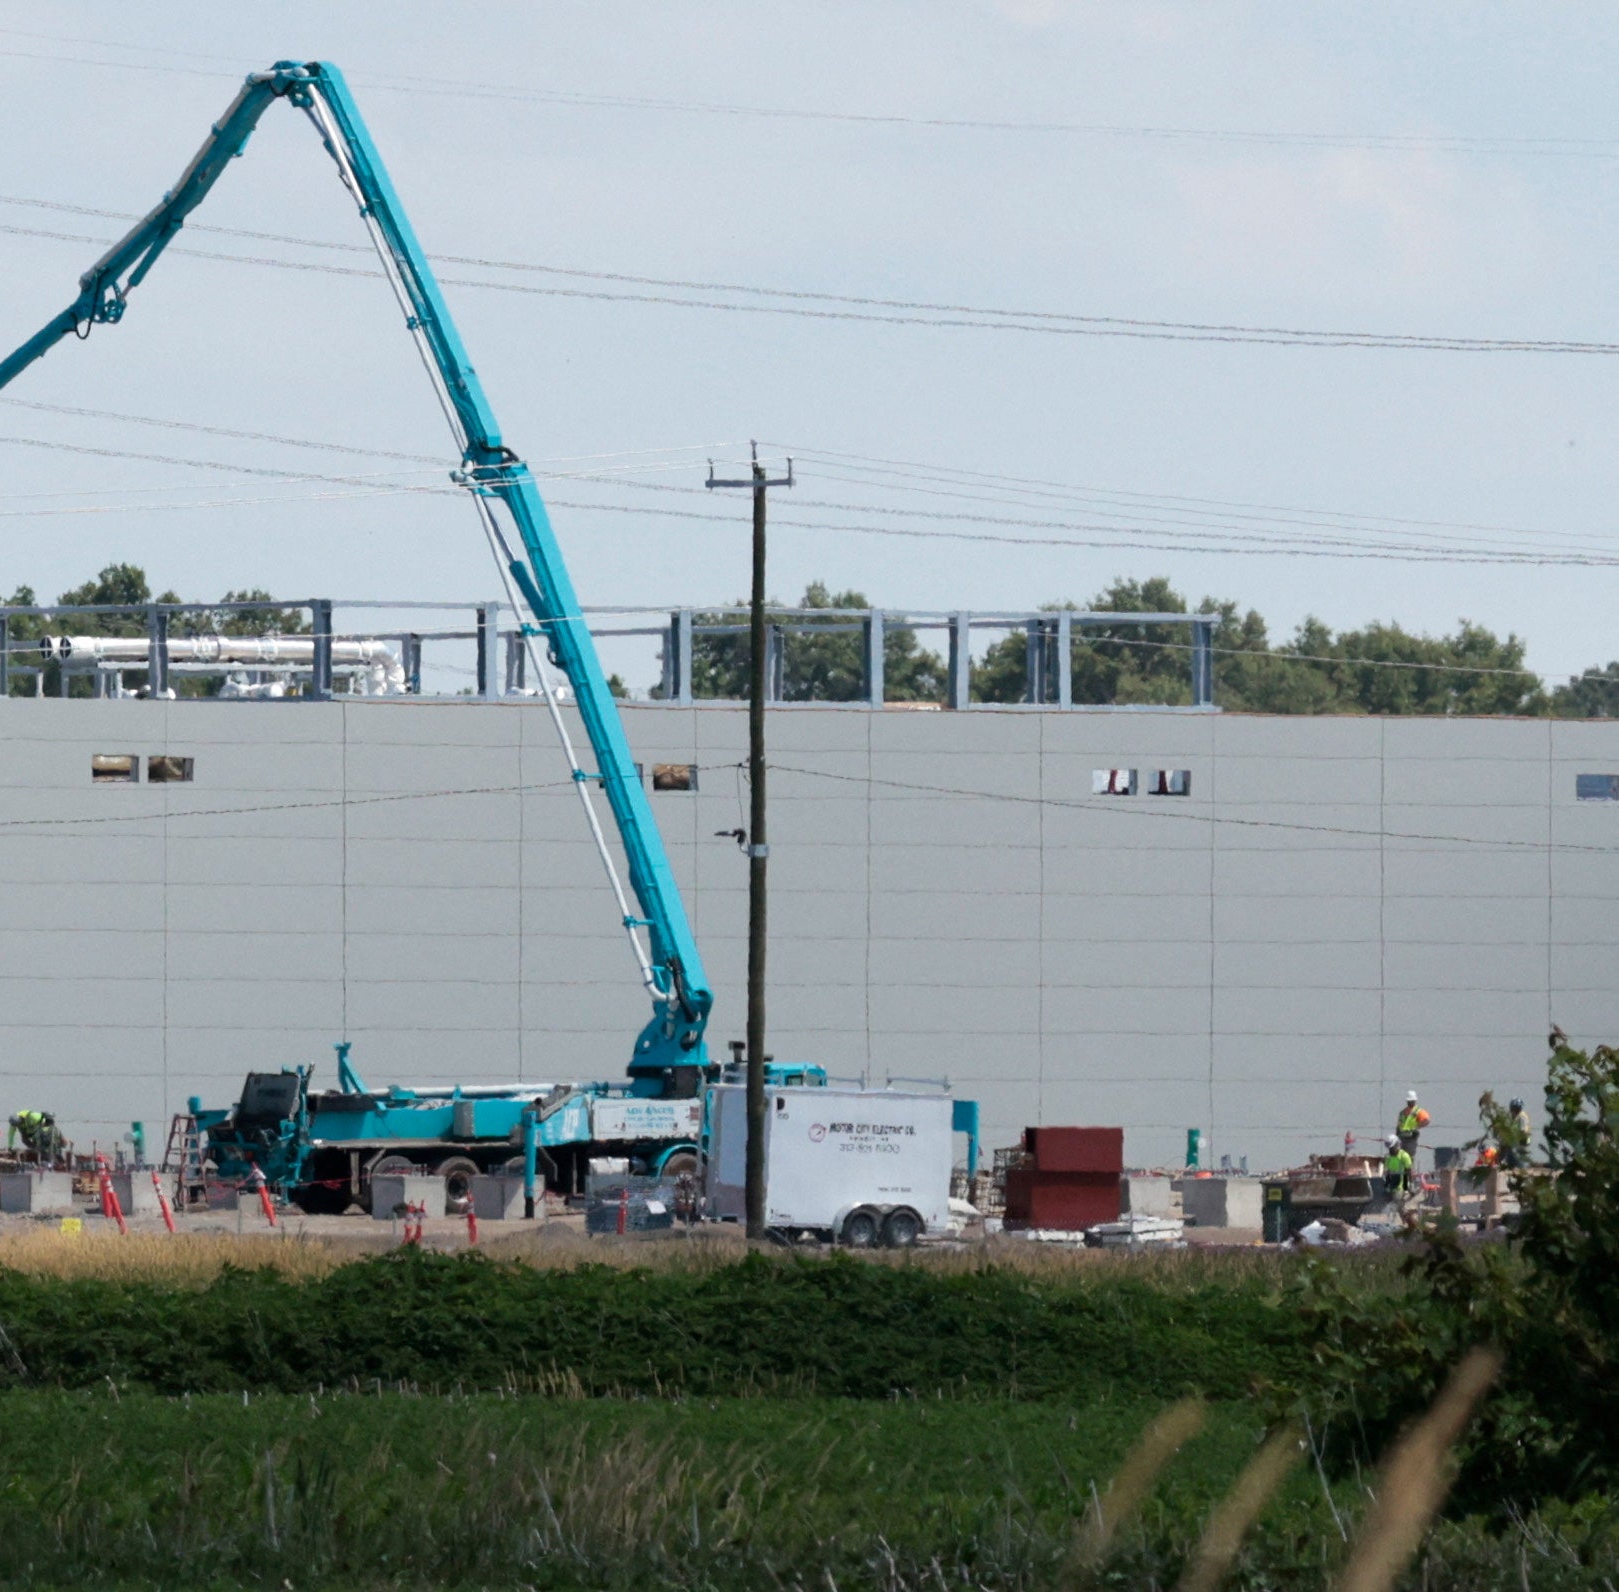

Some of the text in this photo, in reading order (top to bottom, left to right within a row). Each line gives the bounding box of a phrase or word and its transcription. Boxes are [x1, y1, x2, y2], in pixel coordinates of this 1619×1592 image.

[829, 1123, 854, 1134] MOTOR
[856, 1124, 871, 1134] CITY
[872, 1125, 903, 1135] ELECTRIC
